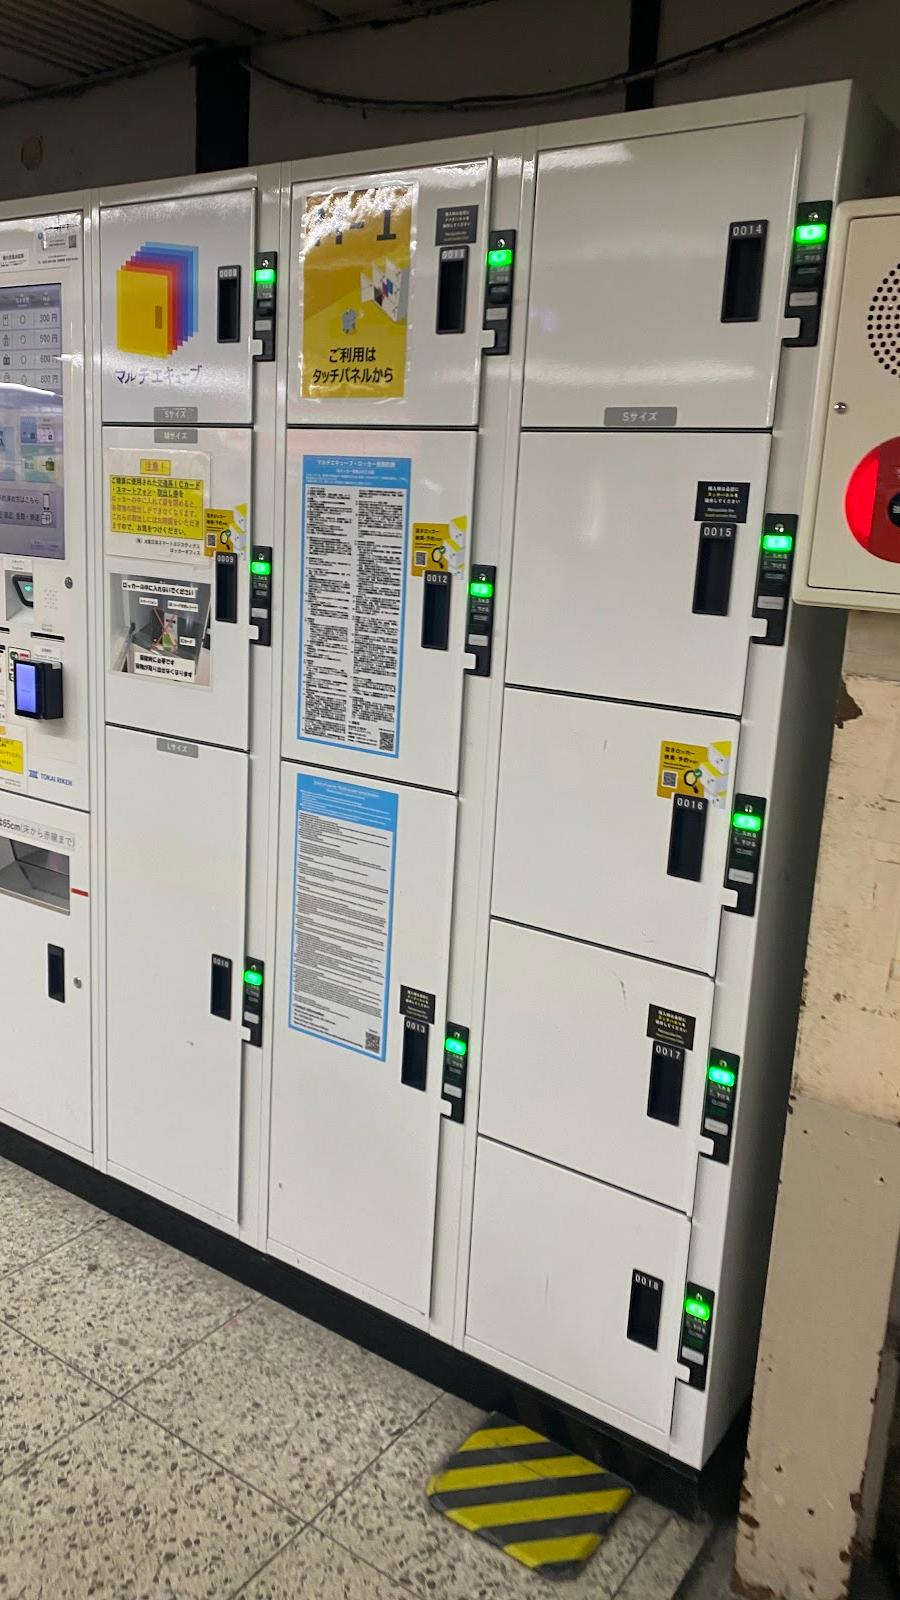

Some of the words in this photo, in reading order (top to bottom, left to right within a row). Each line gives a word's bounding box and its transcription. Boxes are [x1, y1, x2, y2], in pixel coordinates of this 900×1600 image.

[733, 224, 762, 236] 0014
[441, 249, 464, 260] 0011
[328, 347, 377, 363] ご利用は
[312, 367, 394, 384] タッチパネルから
[164, 410, 186, 418] Sサイズ
[621, 411, 658, 422] Sサイズ
[703, 527, 732, 537] 0015
[216, 555, 234, 563] 0009
[426, 574, 448, 584] 0012
[122, 581, 194, 596] ロッカーの中に入れないでください
[665, 746, 695, 755] 空きロッカー
[40, 772, 56, 782] TOKAI
[57, 776, 73, 786] RIKEN
[676, 797, 703, 810] 0016
[405, 1021, 426, 1034] 0013
[655, 1044, 681, 1060] 0017
[635, 1273, 659, 1290] 0018
